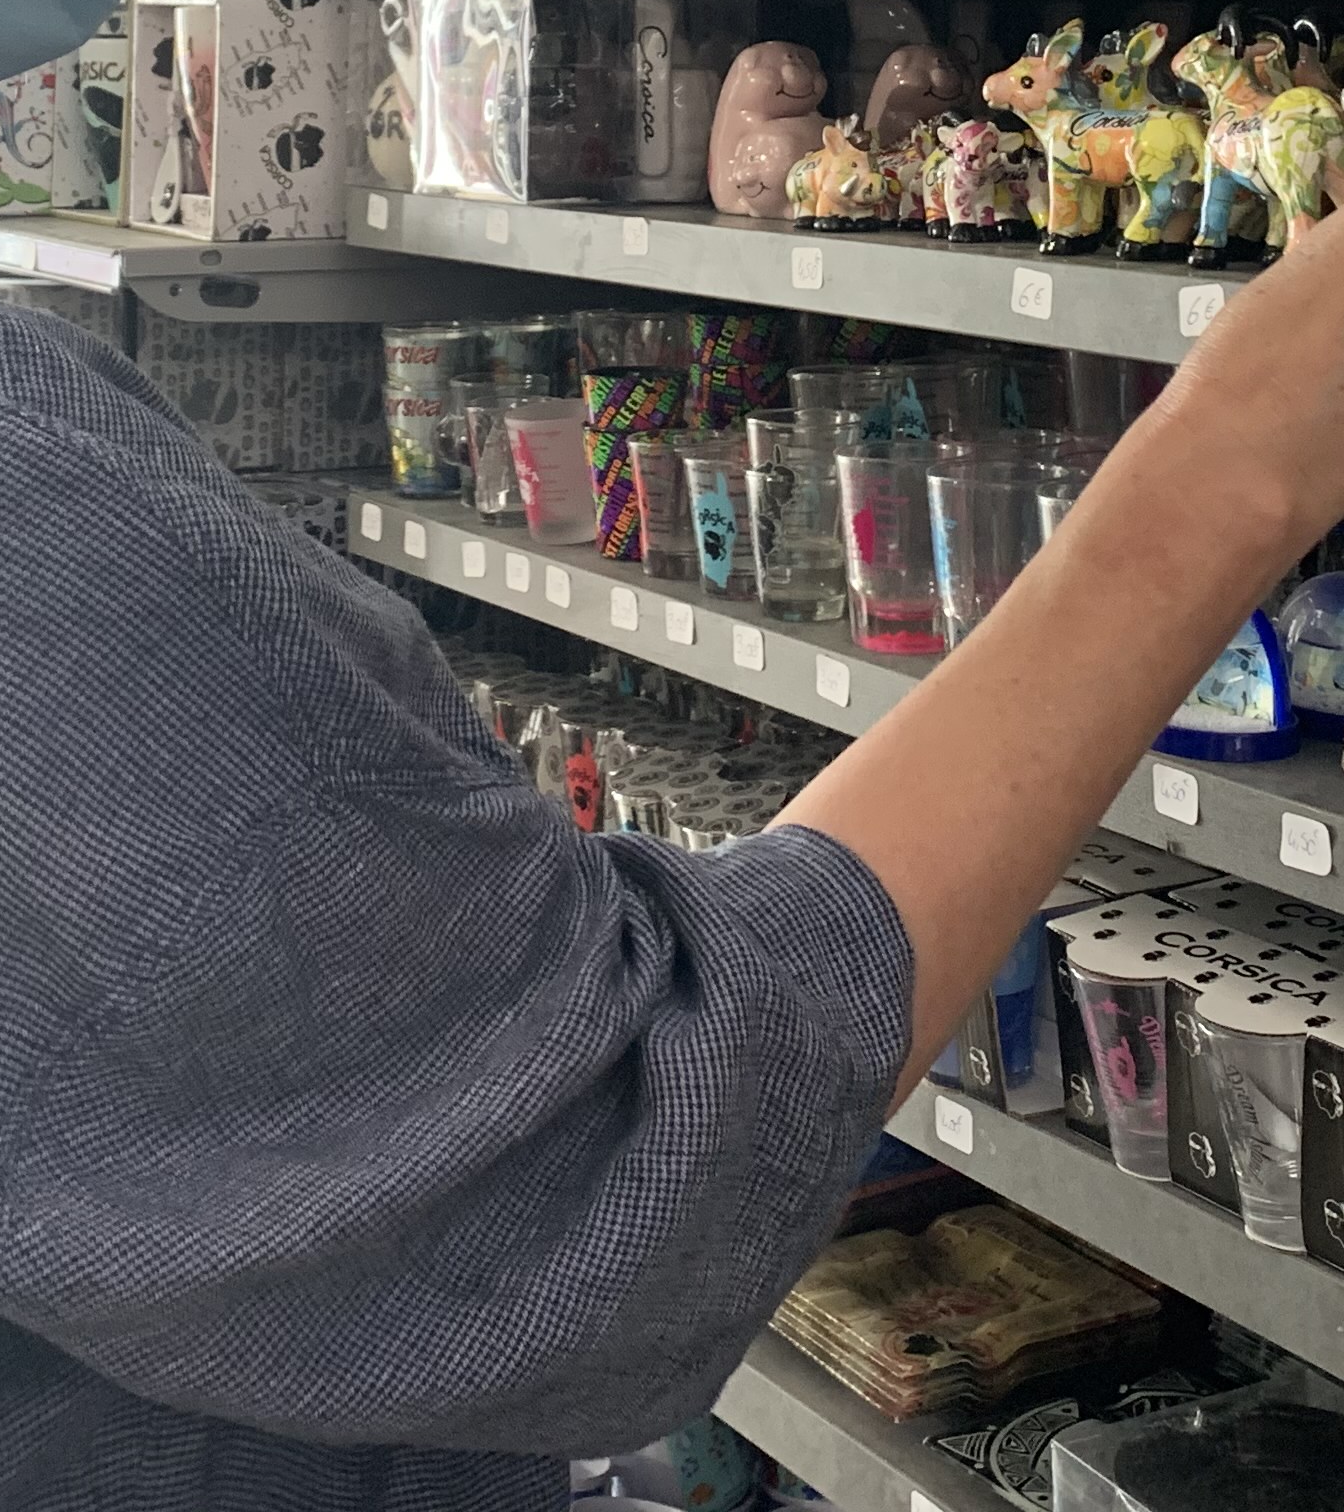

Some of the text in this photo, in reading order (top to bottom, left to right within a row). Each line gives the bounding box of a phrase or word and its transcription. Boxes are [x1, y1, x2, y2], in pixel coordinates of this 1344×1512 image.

[637, 24, 668, 144] Corsica
[259, 144, 294, 190] CORSICA
[1154, 931, 1329, 1007] CORSICA
